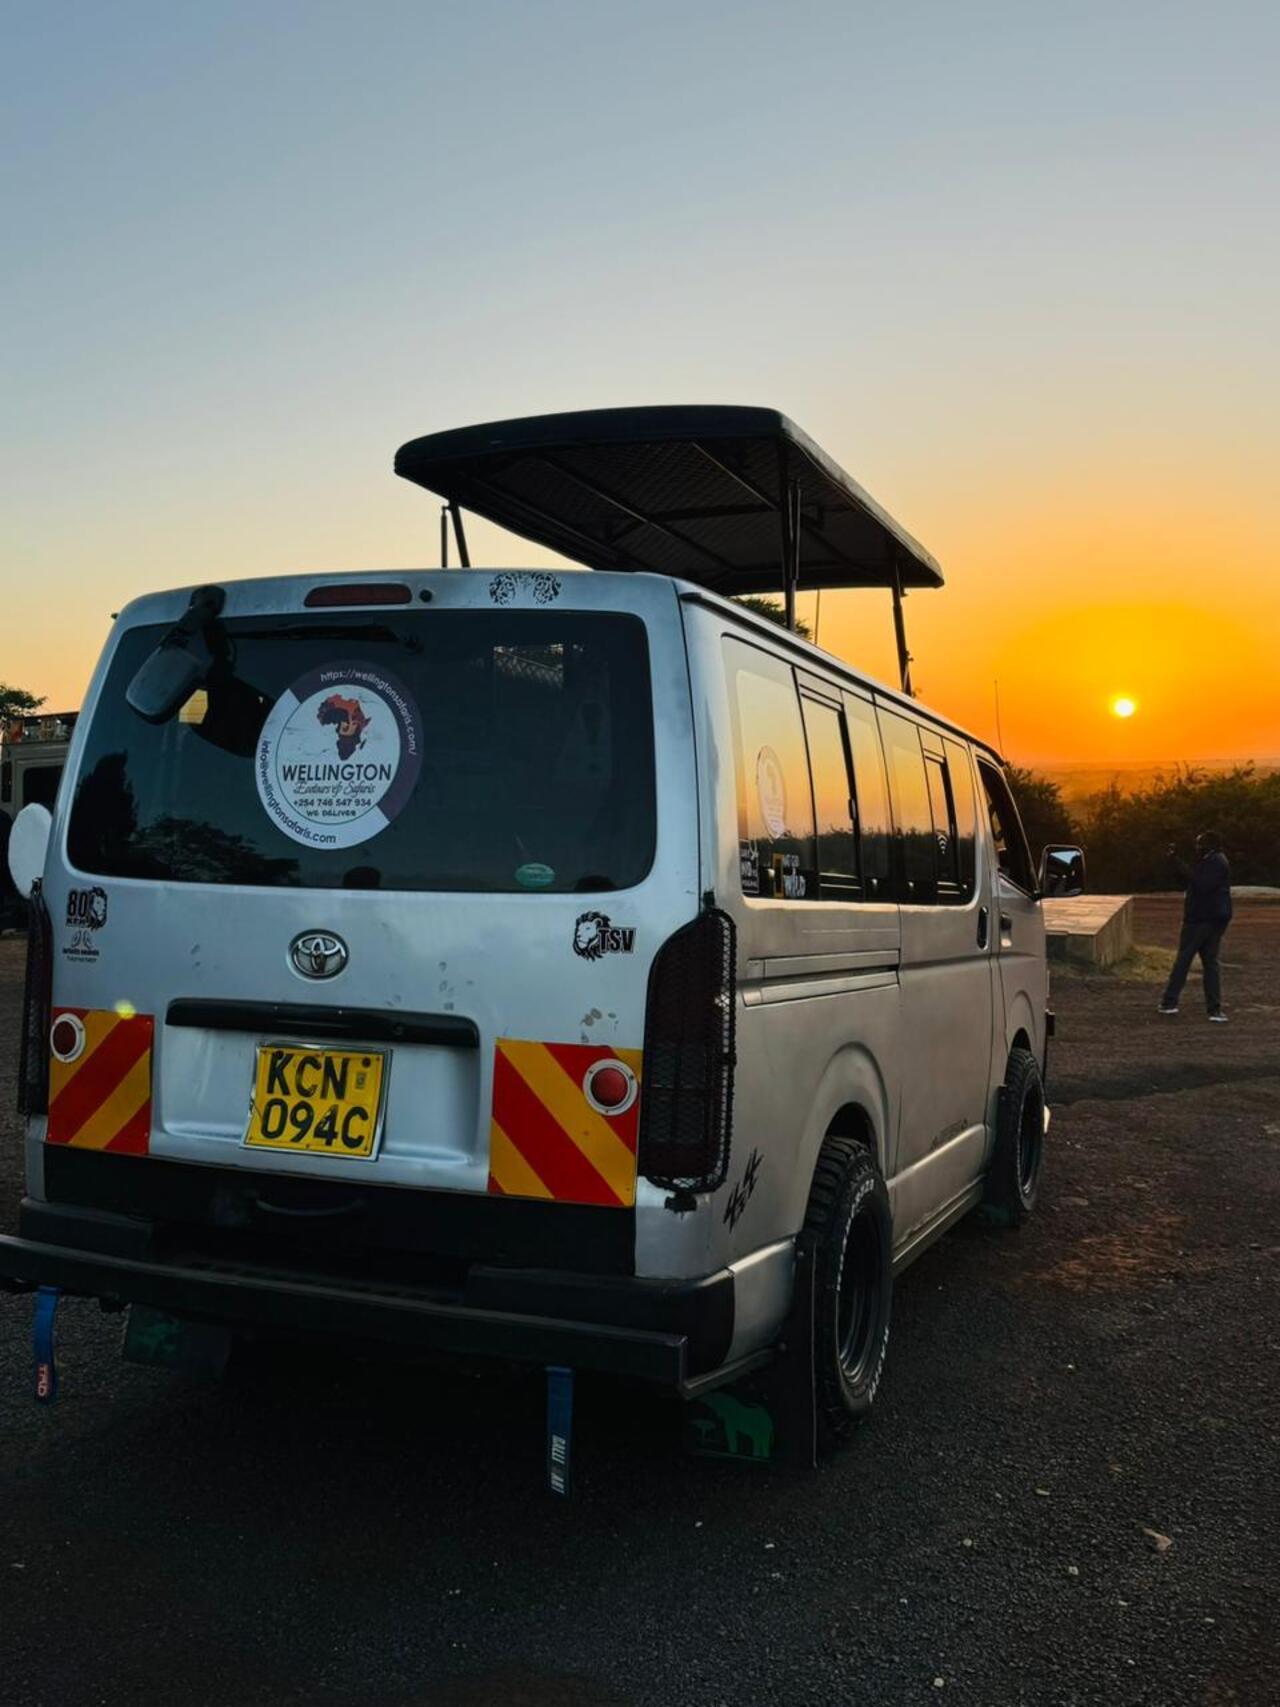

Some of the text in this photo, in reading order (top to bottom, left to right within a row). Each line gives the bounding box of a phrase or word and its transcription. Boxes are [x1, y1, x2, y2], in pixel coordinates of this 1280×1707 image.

[282, 764, 392, 782] WELLINGTON
[293, 798, 315, 807] +254
[335, 799, 353, 807] 547
[354, 799, 372, 807] 934
[68, 890, 87, 917] 80
[598, 928, 636, 954] TSV
[266, 1051, 351, 1101] KCN
[260, 1098, 369, 1149] 094C
